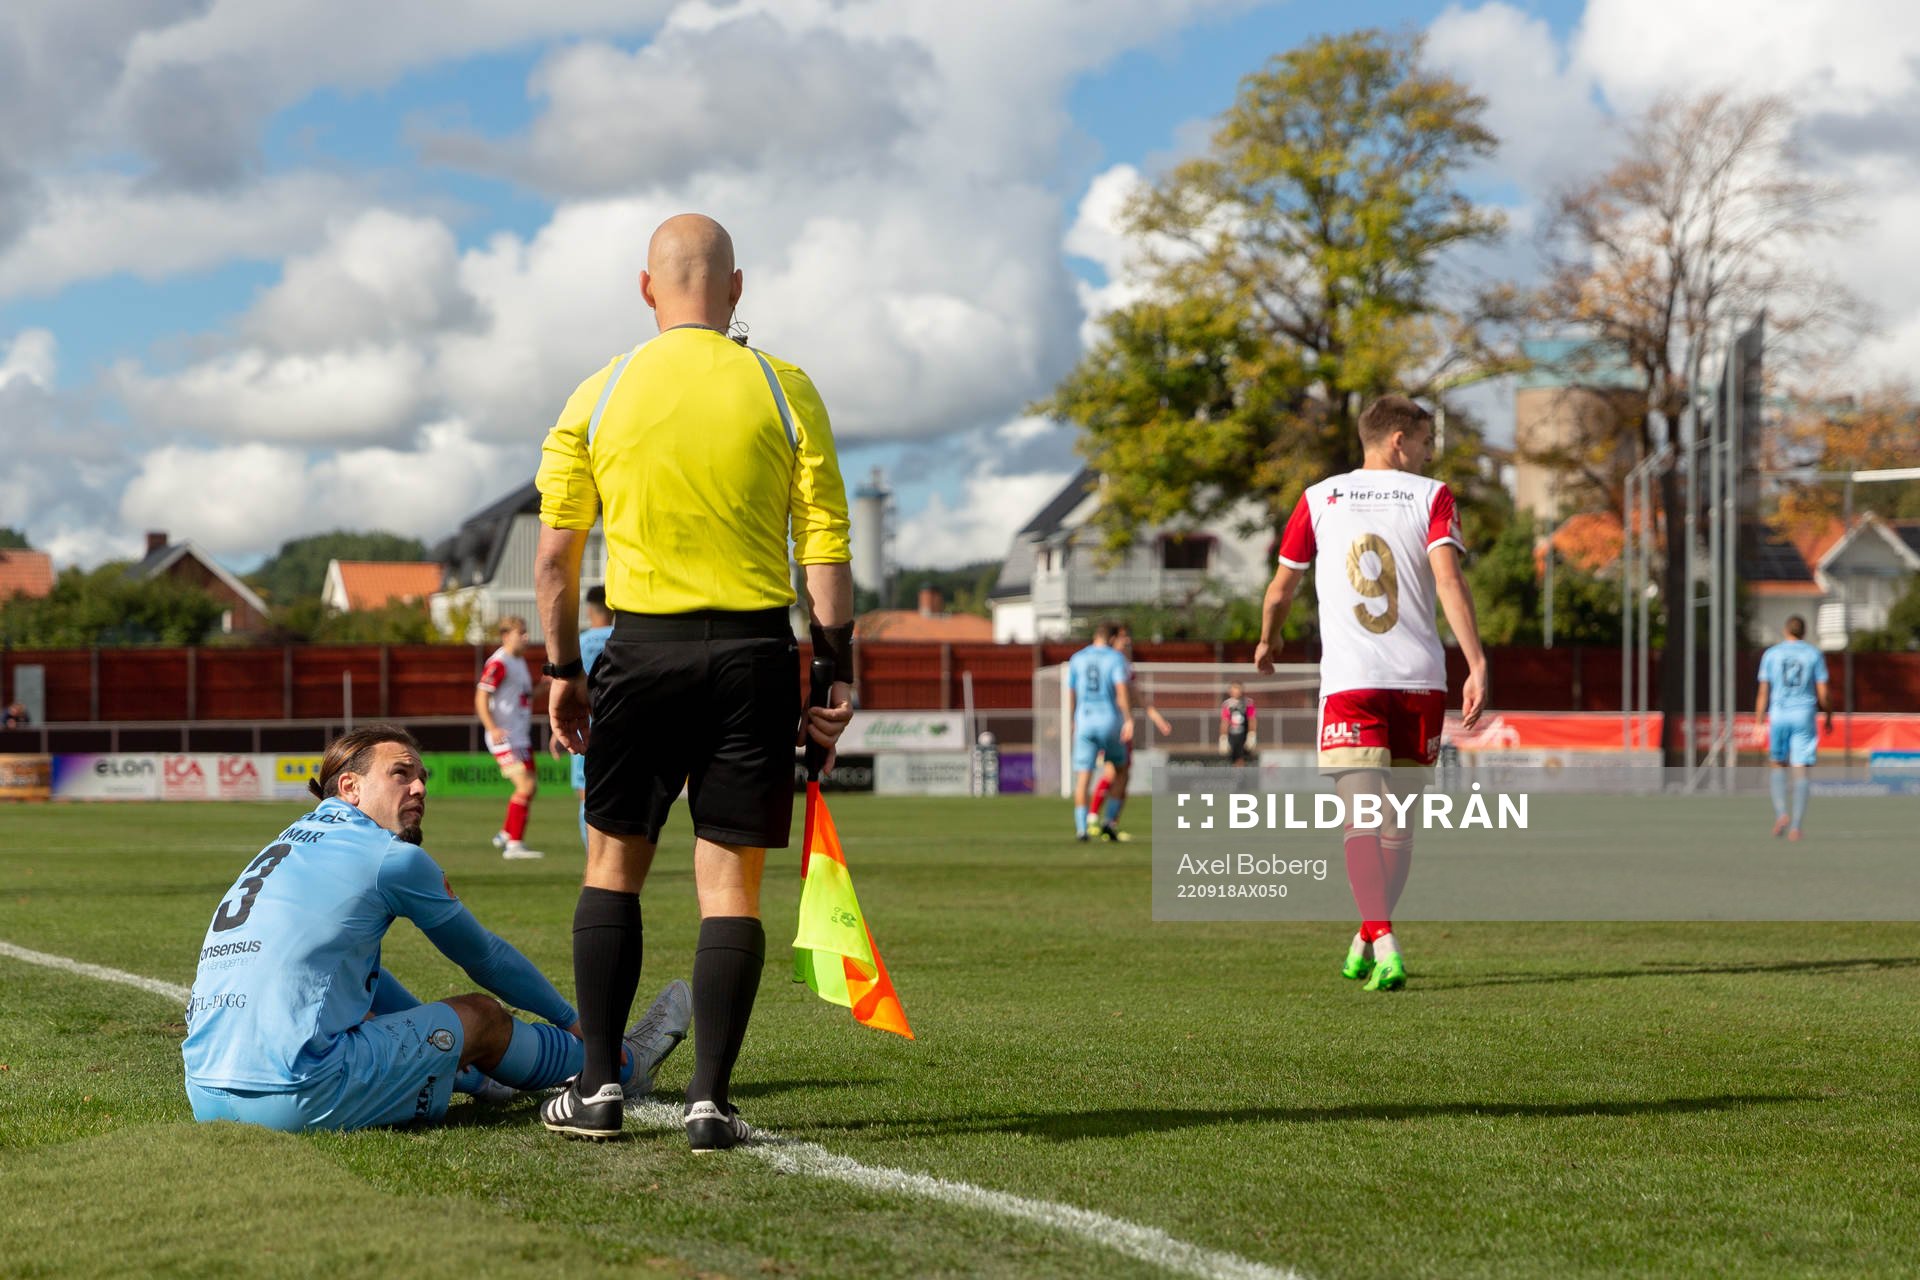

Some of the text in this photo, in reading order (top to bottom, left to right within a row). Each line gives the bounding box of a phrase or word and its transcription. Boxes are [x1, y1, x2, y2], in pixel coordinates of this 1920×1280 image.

[1346, 533, 1399, 635] 9
[1086, 663, 1100, 692] 9
[1323, 722, 1361, 740] PULS
[163, 754, 204, 778] ICA
[217, 754, 258, 778] ICA
[212, 844, 293, 932] 3
